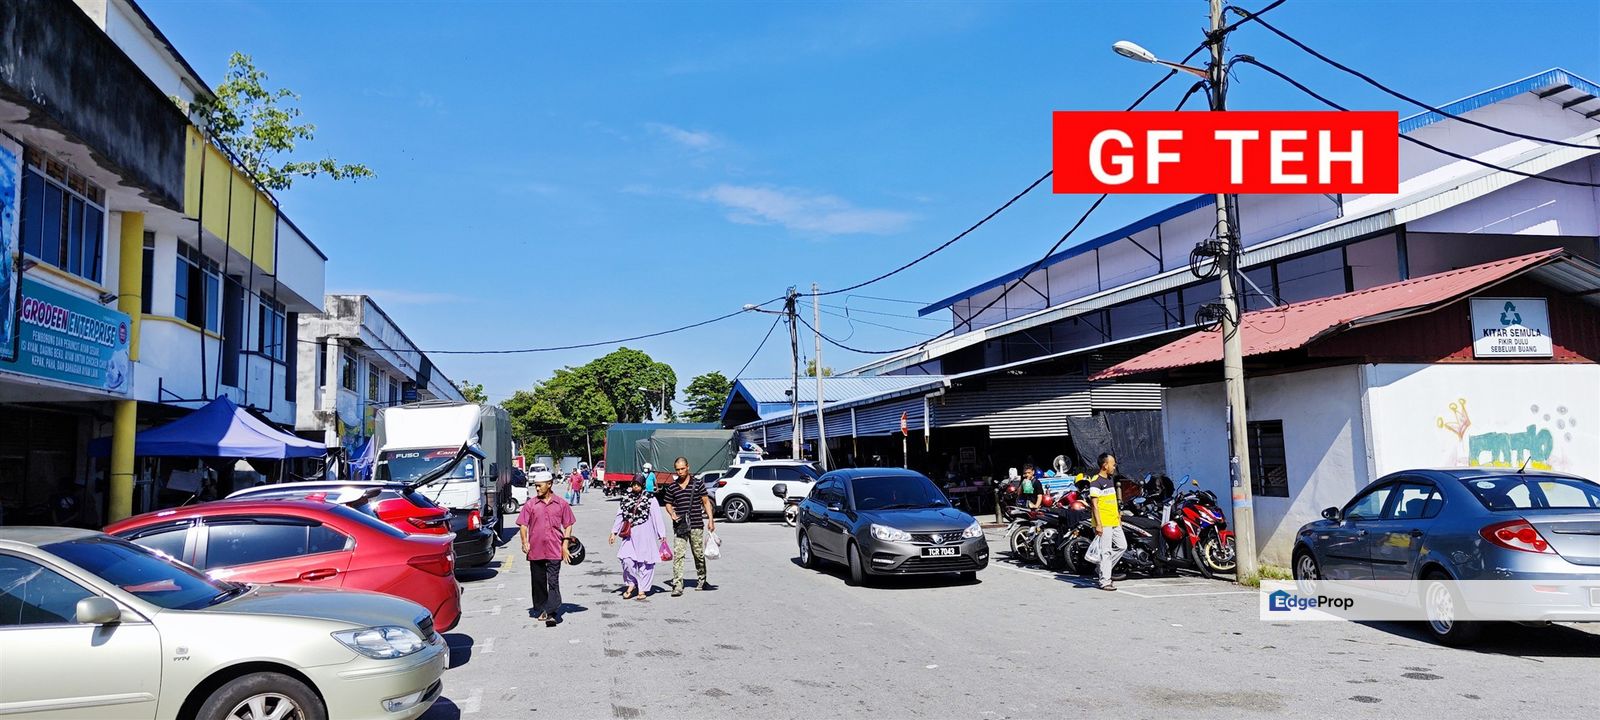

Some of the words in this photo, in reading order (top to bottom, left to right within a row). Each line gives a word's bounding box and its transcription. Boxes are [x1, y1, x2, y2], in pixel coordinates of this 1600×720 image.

[68, 312, 116, 347] ENTERPRISE
[1483, 328, 1508, 337] KITAR
[1510, 328, 1541, 337] SEMULA
[1490, 345, 1516, 353] SEBELUM
[940, 547, 955, 555] 7043
